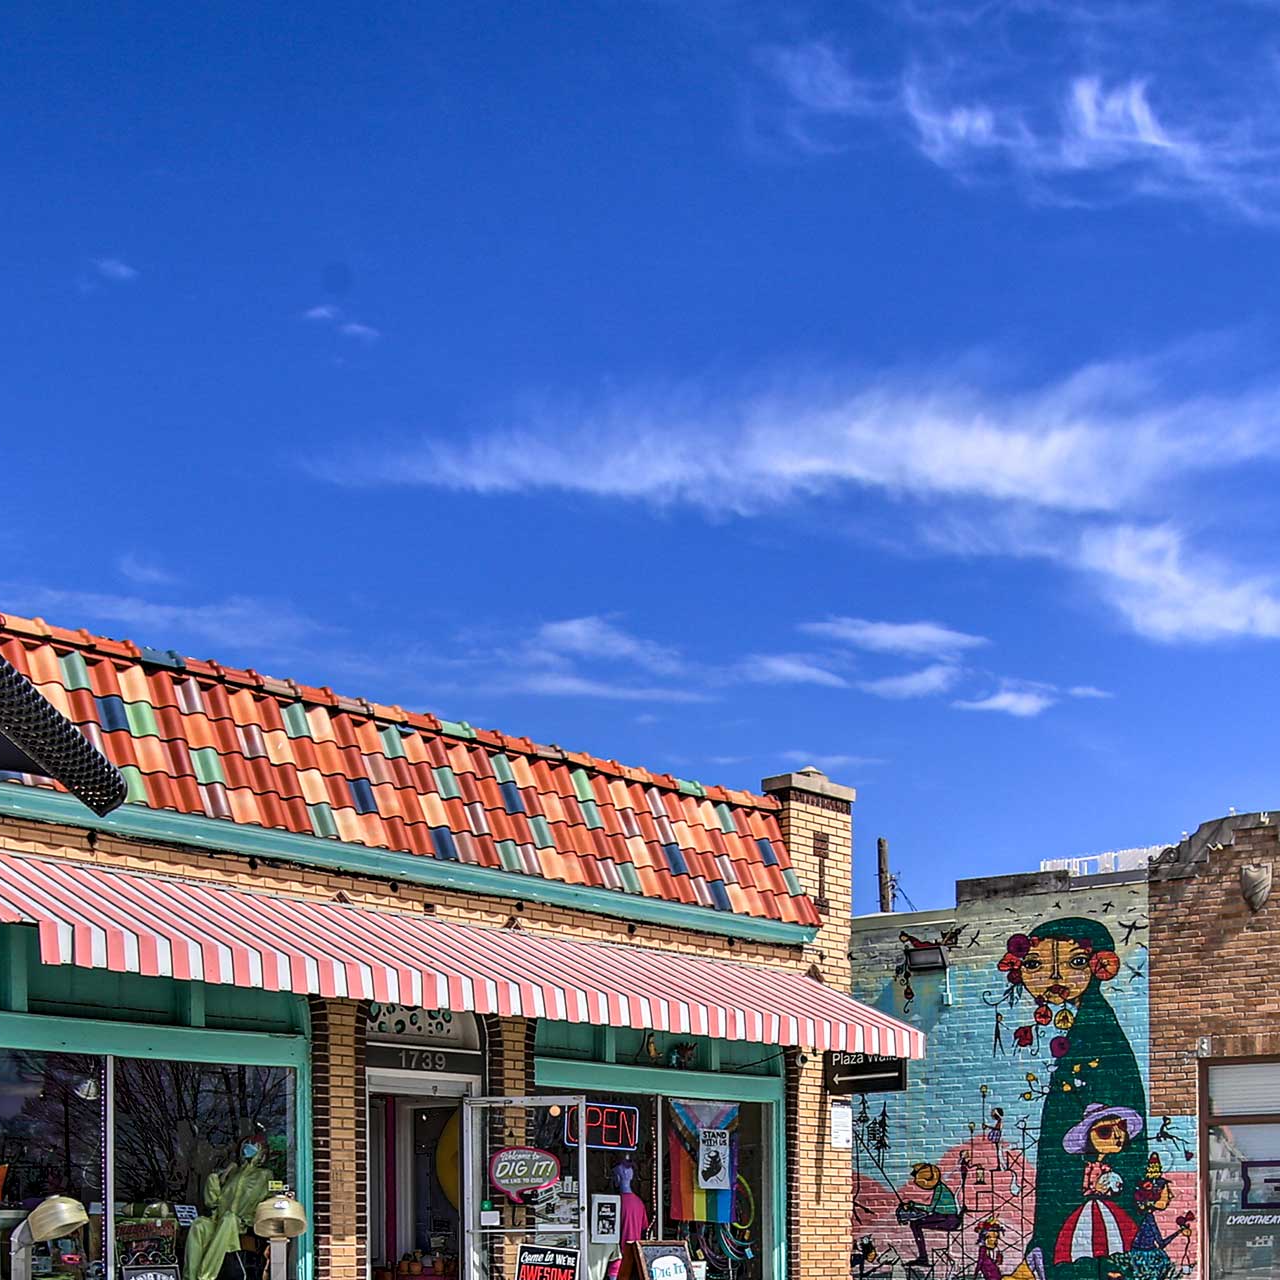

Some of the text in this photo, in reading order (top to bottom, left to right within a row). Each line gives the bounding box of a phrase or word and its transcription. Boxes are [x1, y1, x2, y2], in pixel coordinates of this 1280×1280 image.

[399, 1050, 446, 1071] 1739
[832, 1053, 864, 1066] Plaza
[567, 1106, 636, 1147] OPEN
[702, 1131, 727, 1139] STAND
[495, 1160, 554, 1178] DIG IT!
[521, 1251, 544, 1263] Come
